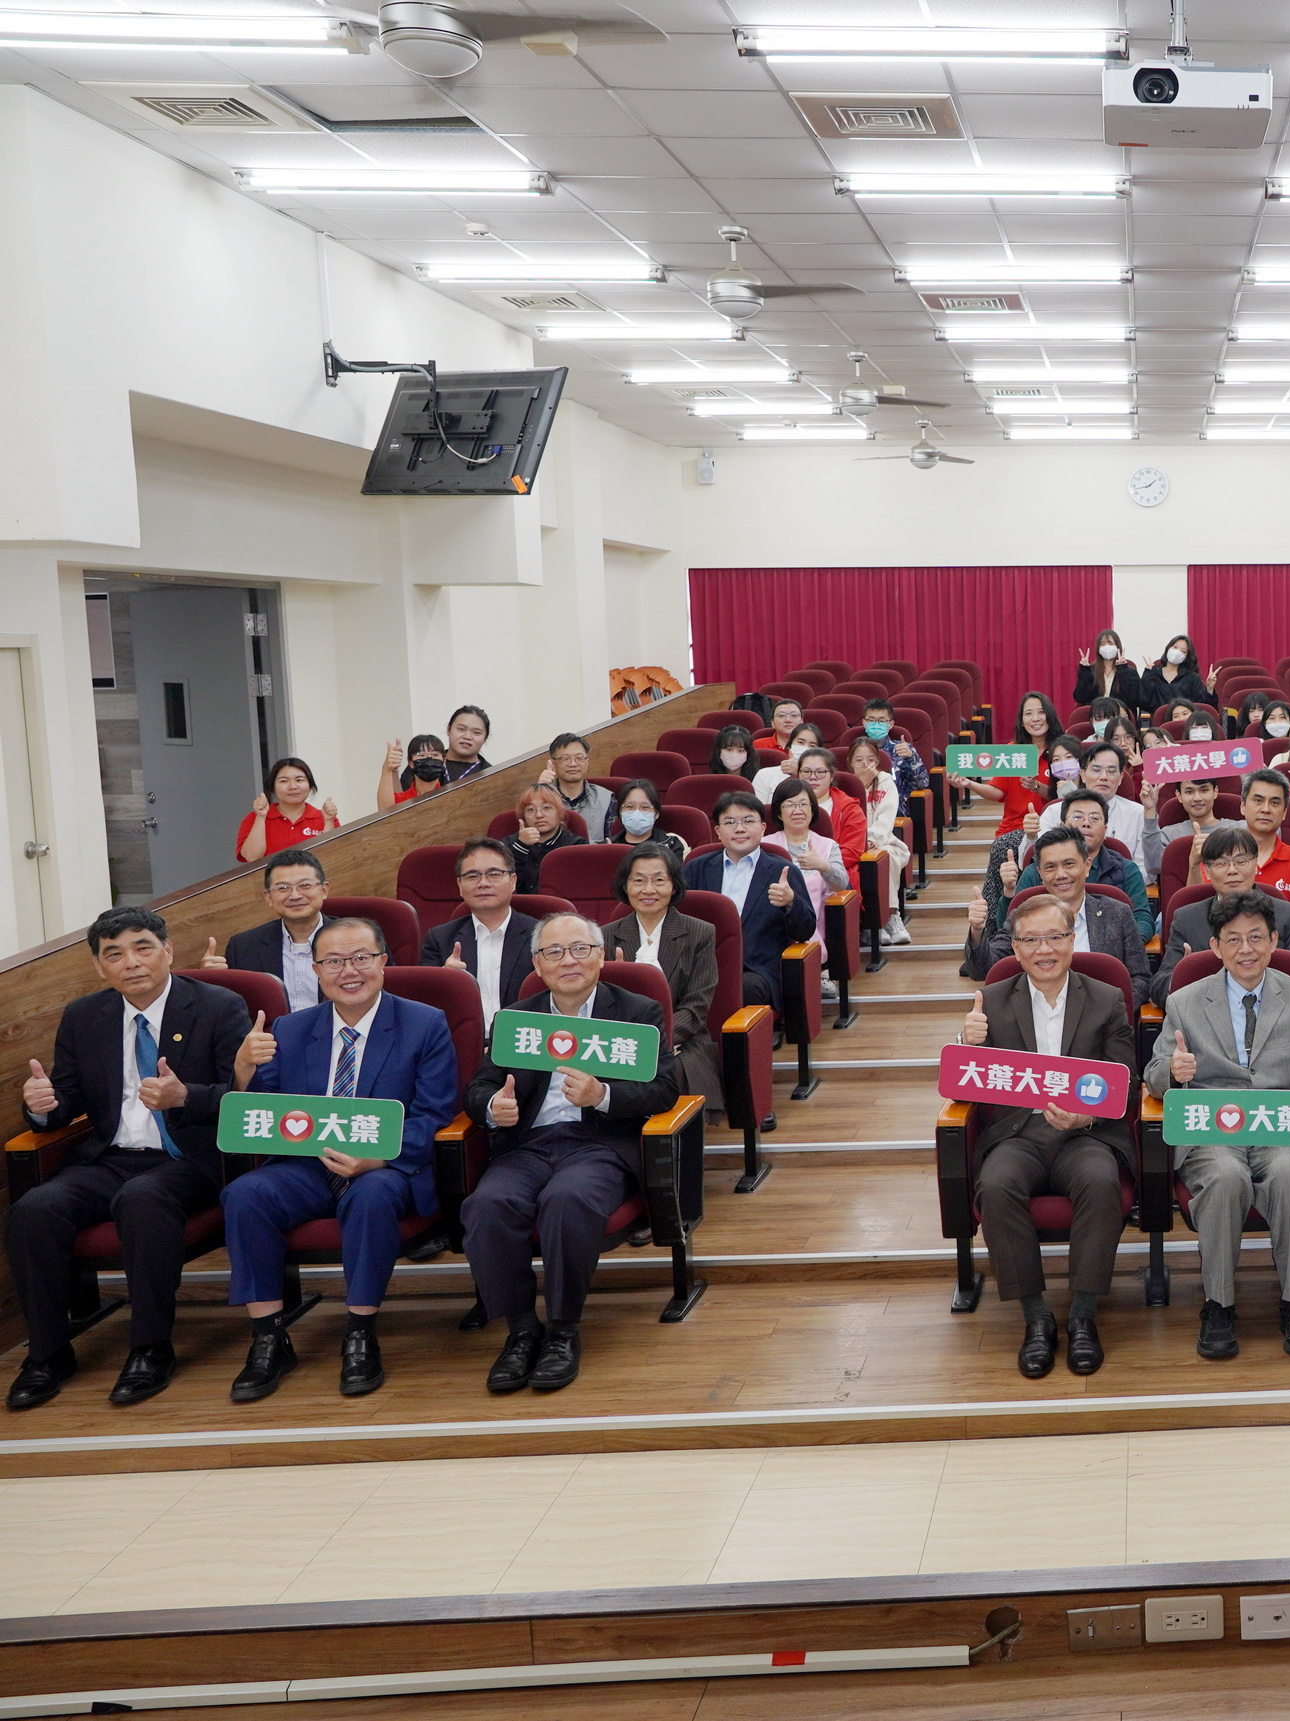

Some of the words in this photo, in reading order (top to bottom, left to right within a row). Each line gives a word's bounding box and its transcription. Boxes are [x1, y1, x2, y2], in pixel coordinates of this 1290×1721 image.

[957, 753, 974, 770] 我
[995, 753, 1027, 769] 大葉
[1155, 750, 1227, 775] 大葉大學
[515, 1027, 543, 1055] 我
[580, 1035, 638, 1066] 大葉
[957, 1060, 1070, 1098] 大葉大學
[243, 1109, 274, 1138] 我
[317, 1113, 381, 1144] 大葉
[1184, 1104, 1211, 1131] 我
